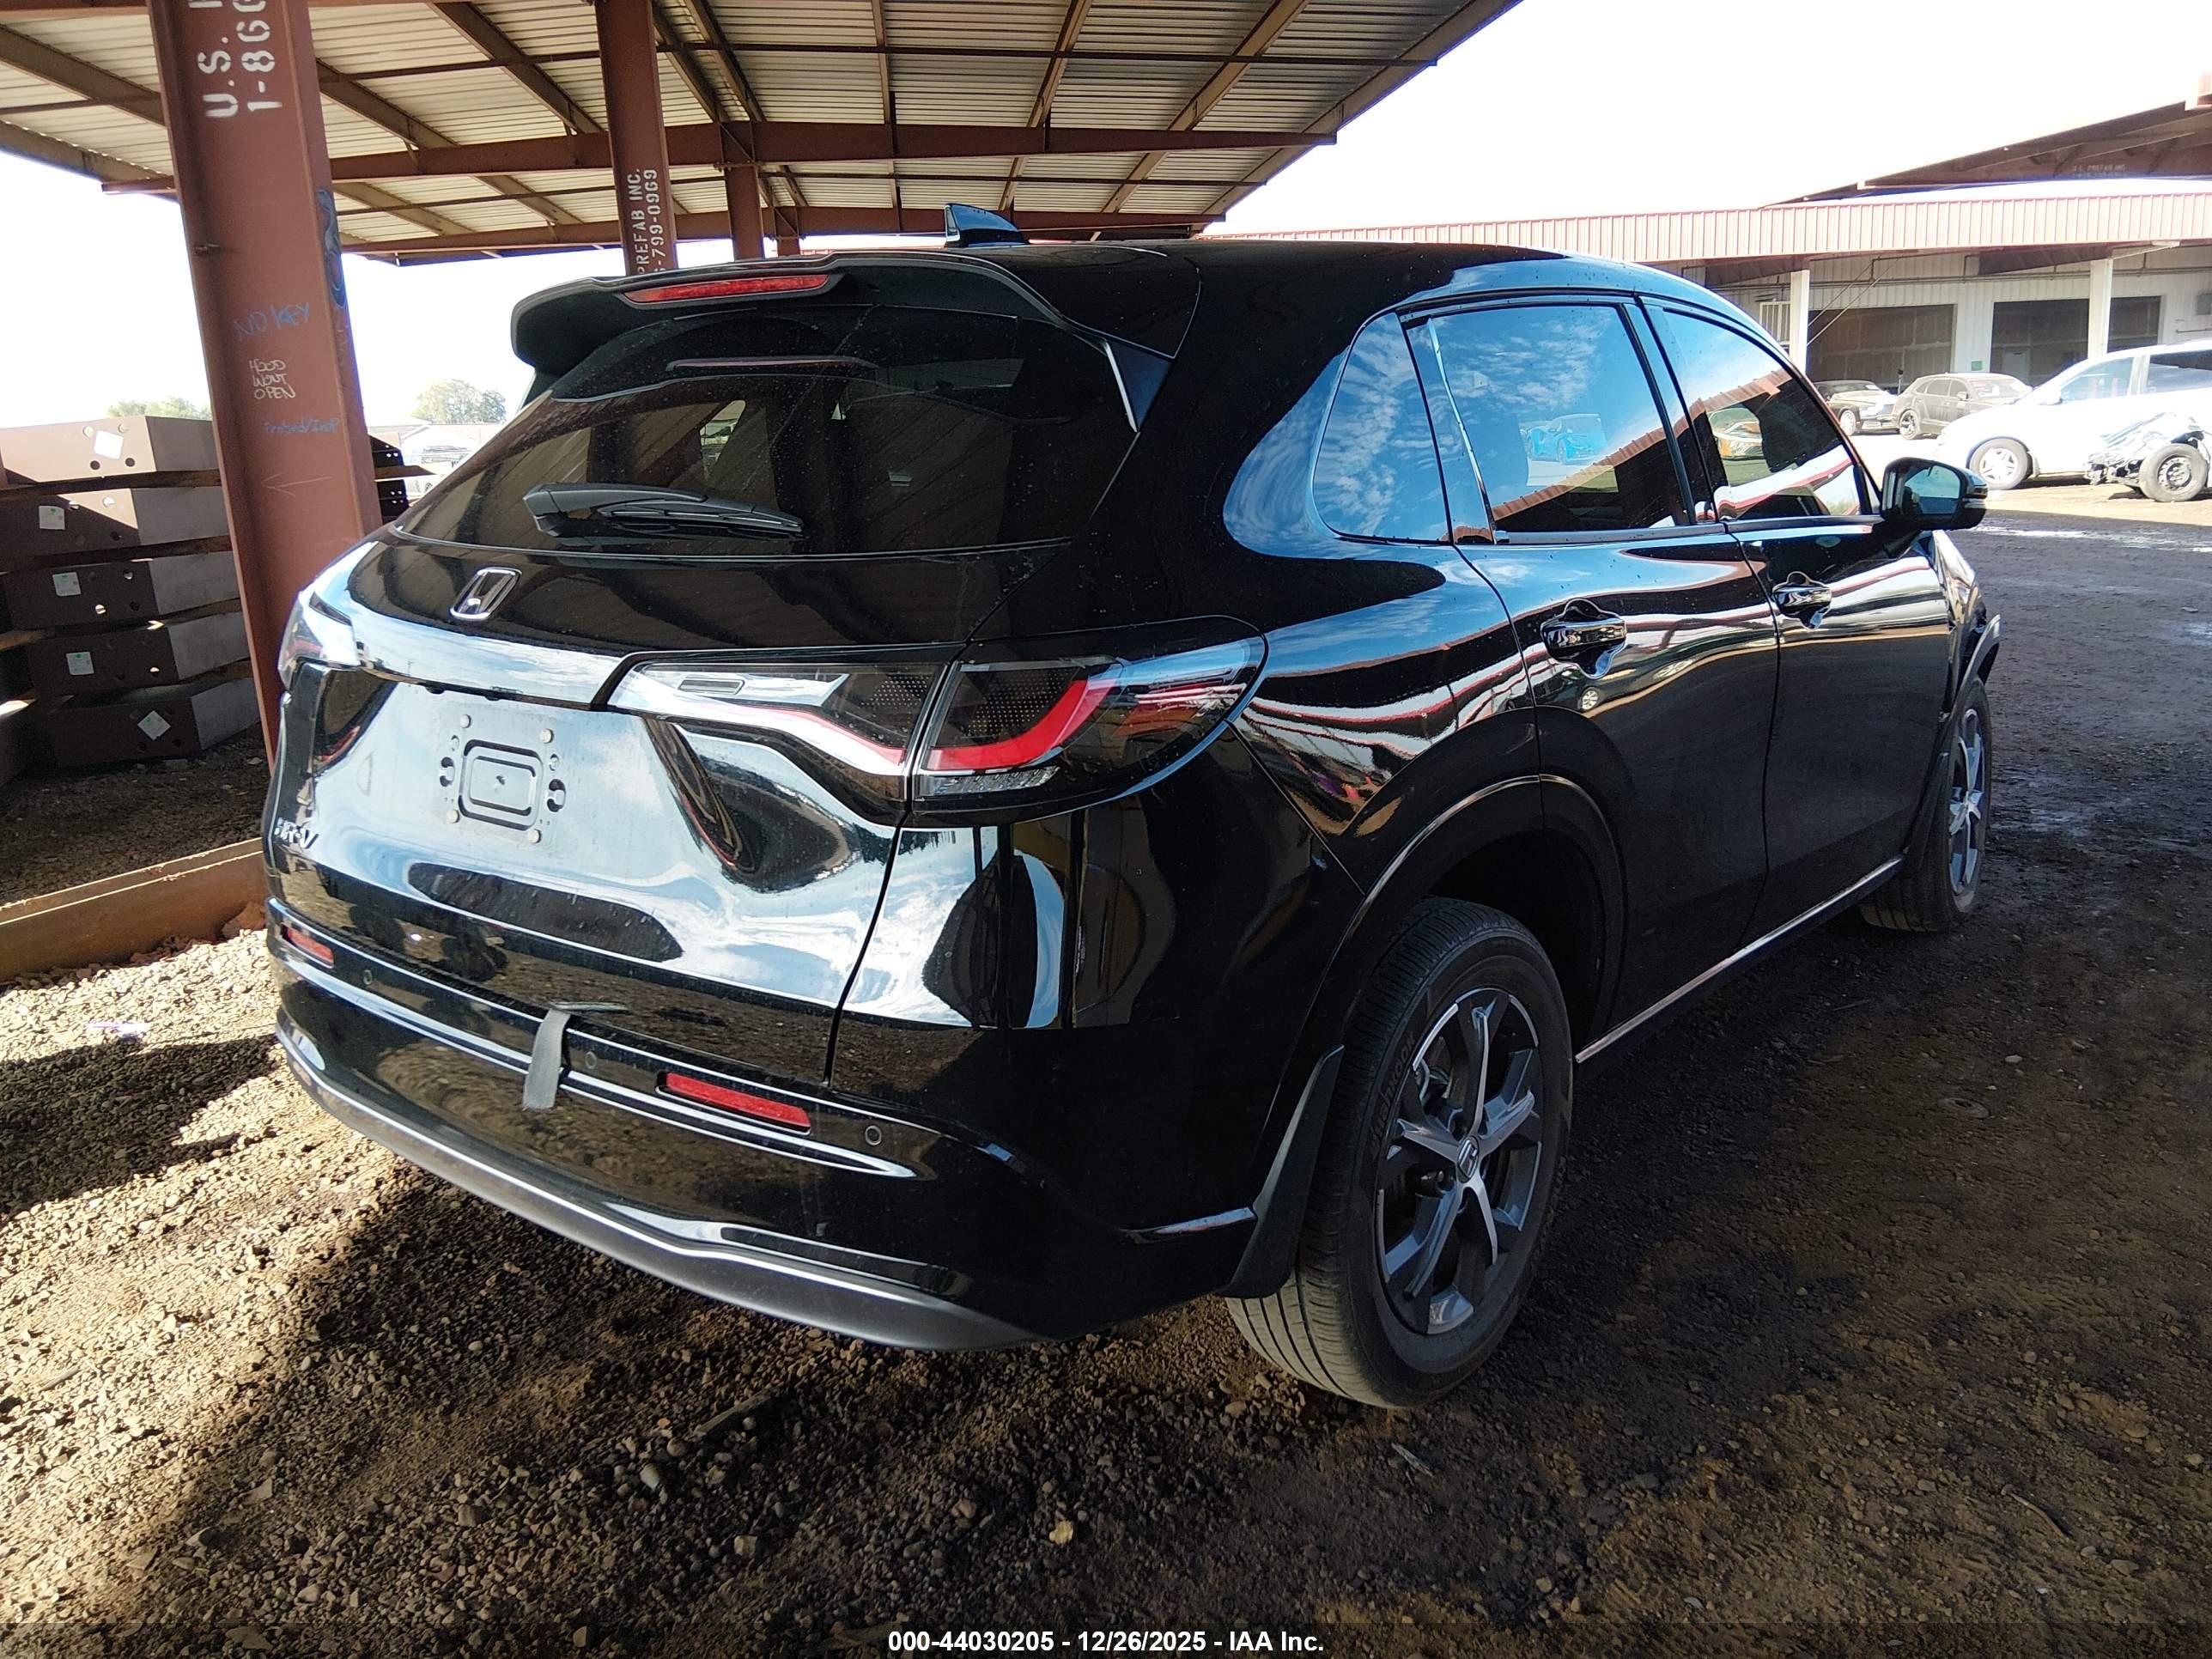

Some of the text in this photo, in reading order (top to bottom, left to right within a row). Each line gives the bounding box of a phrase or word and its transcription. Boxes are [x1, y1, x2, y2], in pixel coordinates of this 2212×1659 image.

[198, 36, 239, 118] U.S.
[627, 168, 643, 201] INC.
[248, 358, 287, 374] HOOD
[253, 384, 296, 400] OPEN
